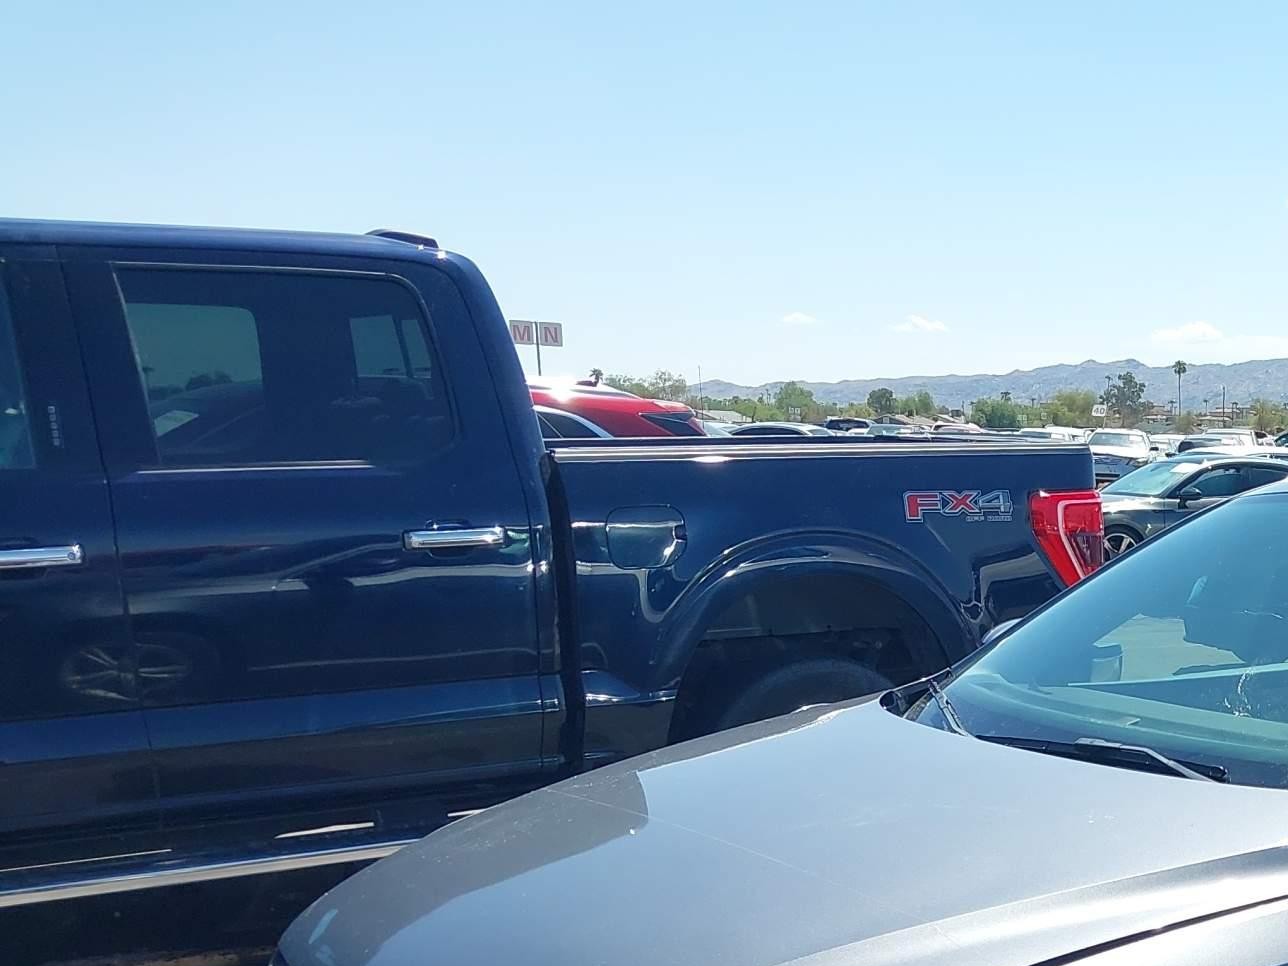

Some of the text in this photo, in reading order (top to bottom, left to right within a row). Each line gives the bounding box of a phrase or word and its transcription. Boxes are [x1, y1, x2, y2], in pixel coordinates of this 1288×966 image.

[512, 325, 559, 344] M N
[1093, 407, 1106, 415] 40
[903, 489, 1014, 523] FX4
